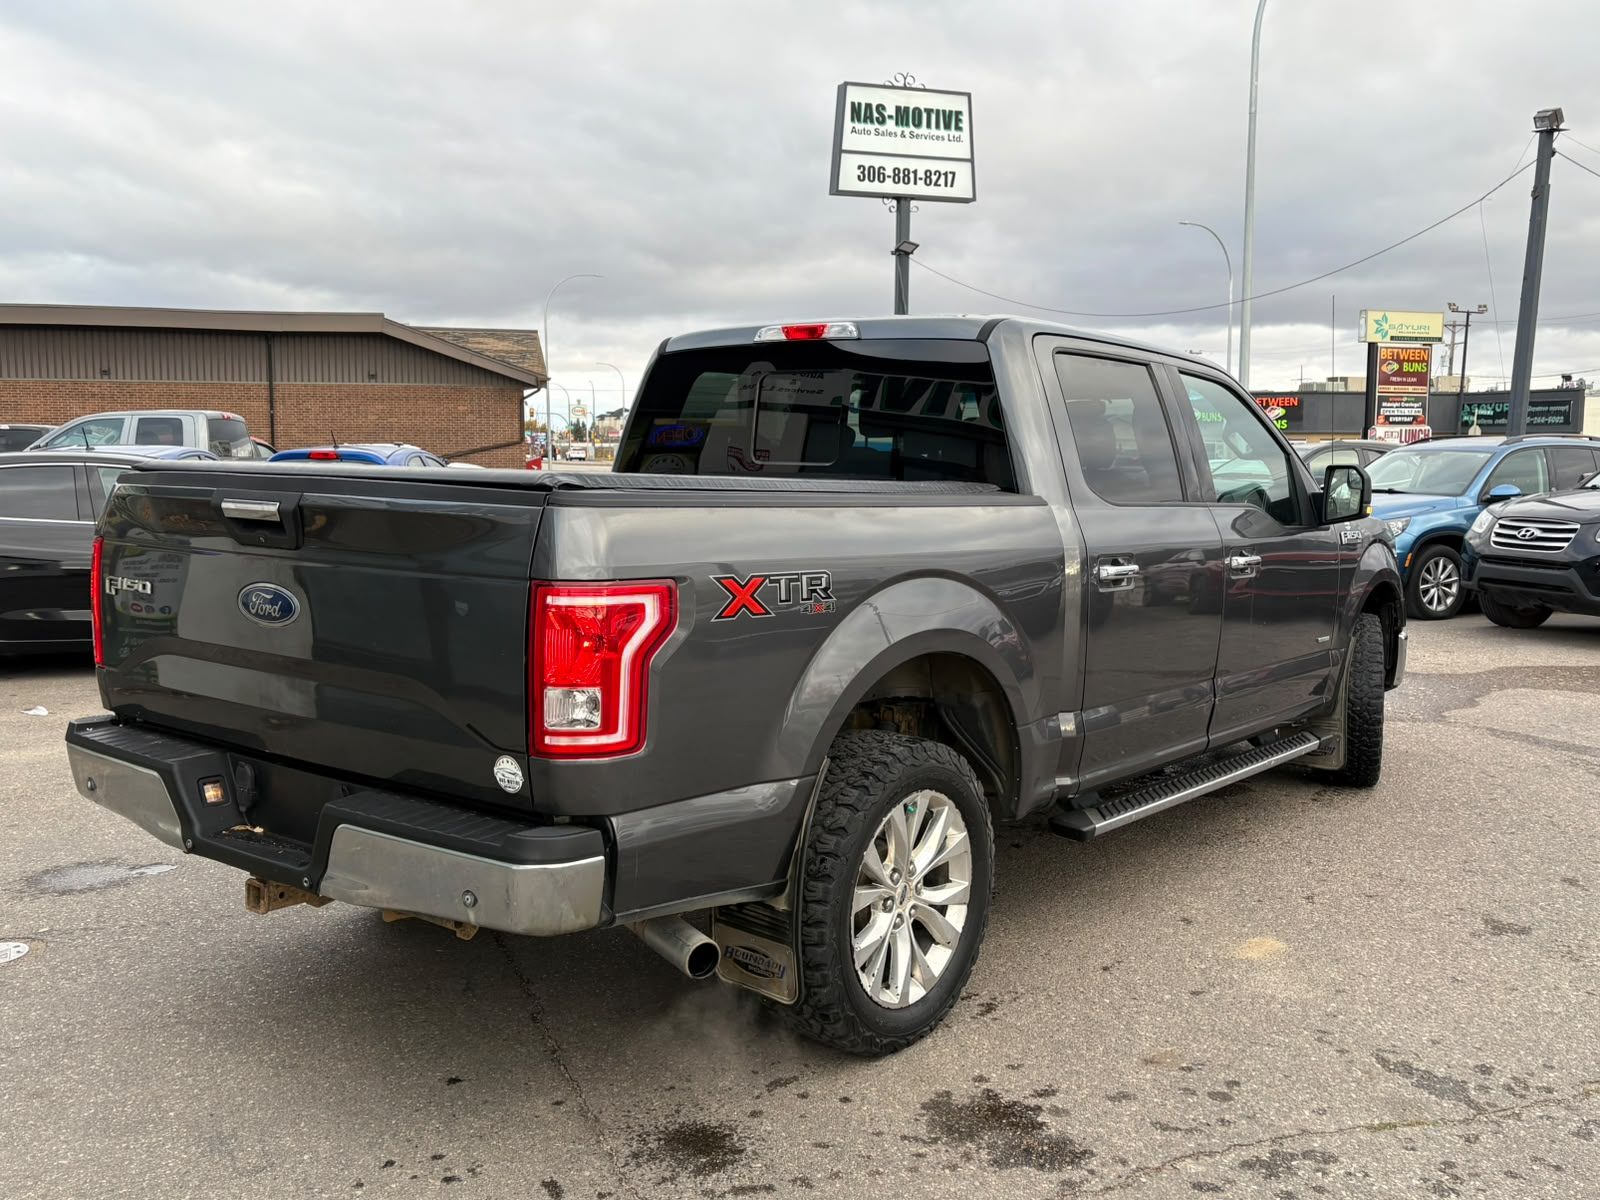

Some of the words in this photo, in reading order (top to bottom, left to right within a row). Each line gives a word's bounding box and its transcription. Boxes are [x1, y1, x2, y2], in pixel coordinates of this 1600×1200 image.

[850, 101, 963, 132] NAS-MOTIVE
[850, 126, 872, 136] Auto
[874, 128, 898, 138] Sales
[900, 130, 906, 139] &
[908, 130, 945, 142] Services
[947, 134, 964, 143] Ltd.
[856, 164, 956, 188] 306-881-8217
[1388, 323, 1430, 332] SAYURI
[1380, 348, 1429, 360] BETWEEN
[1403, 362, 1427, 372] BUNS
[1256, 397, 1298, 406] ETWEEN
[1200, 411, 1222, 422] BUNS
[1273, 420, 1287, 429] NS
[1399, 428, 1430, 444] LUNCH
[709, 570, 837, 622] XTR
[250, 591, 282, 617] Ford
